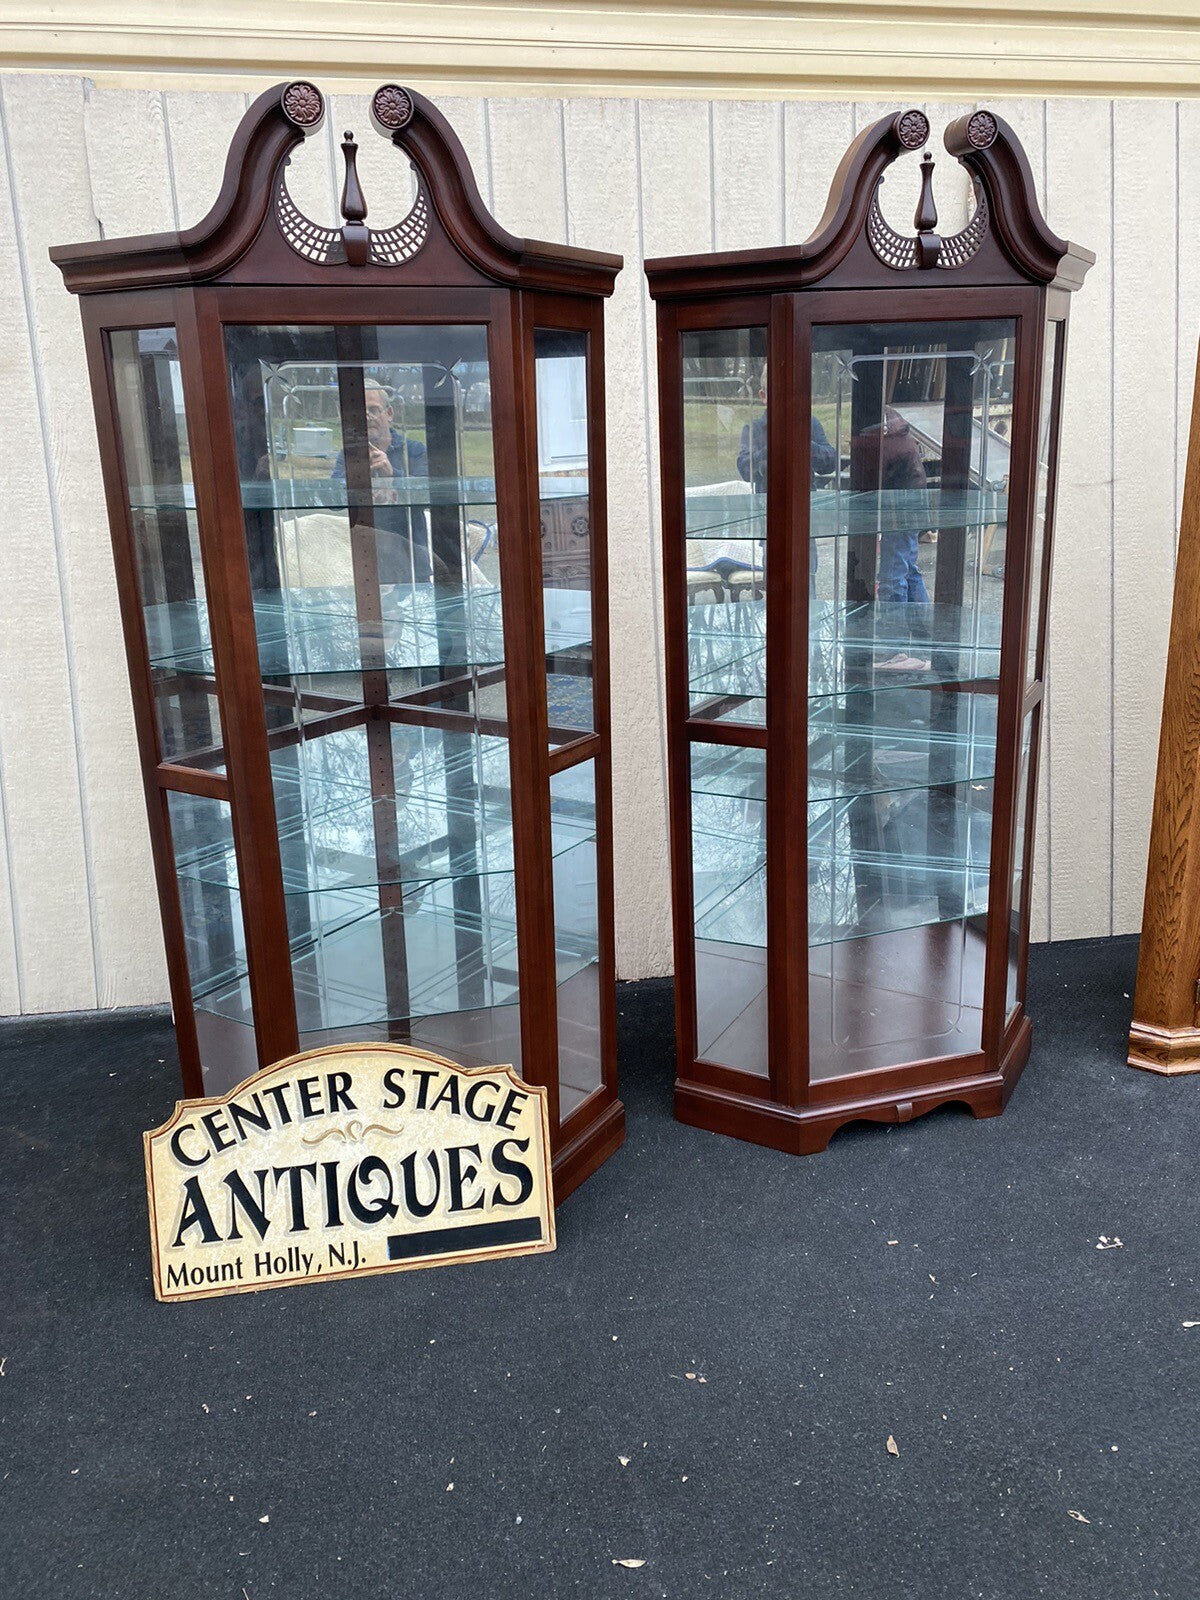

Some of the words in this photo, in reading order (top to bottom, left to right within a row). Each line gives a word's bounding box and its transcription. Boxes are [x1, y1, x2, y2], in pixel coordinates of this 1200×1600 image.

[170, 1071, 357, 1167] CENTER
[382, 1067, 530, 1131] STAGE
[171, 1137, 534, 1247] ANTIQUES
[166, 1255, 244, 1288] Mount
[254, 1247, 322, 1277] Holly,
[329, 1241, 367, 1270] N.J.
